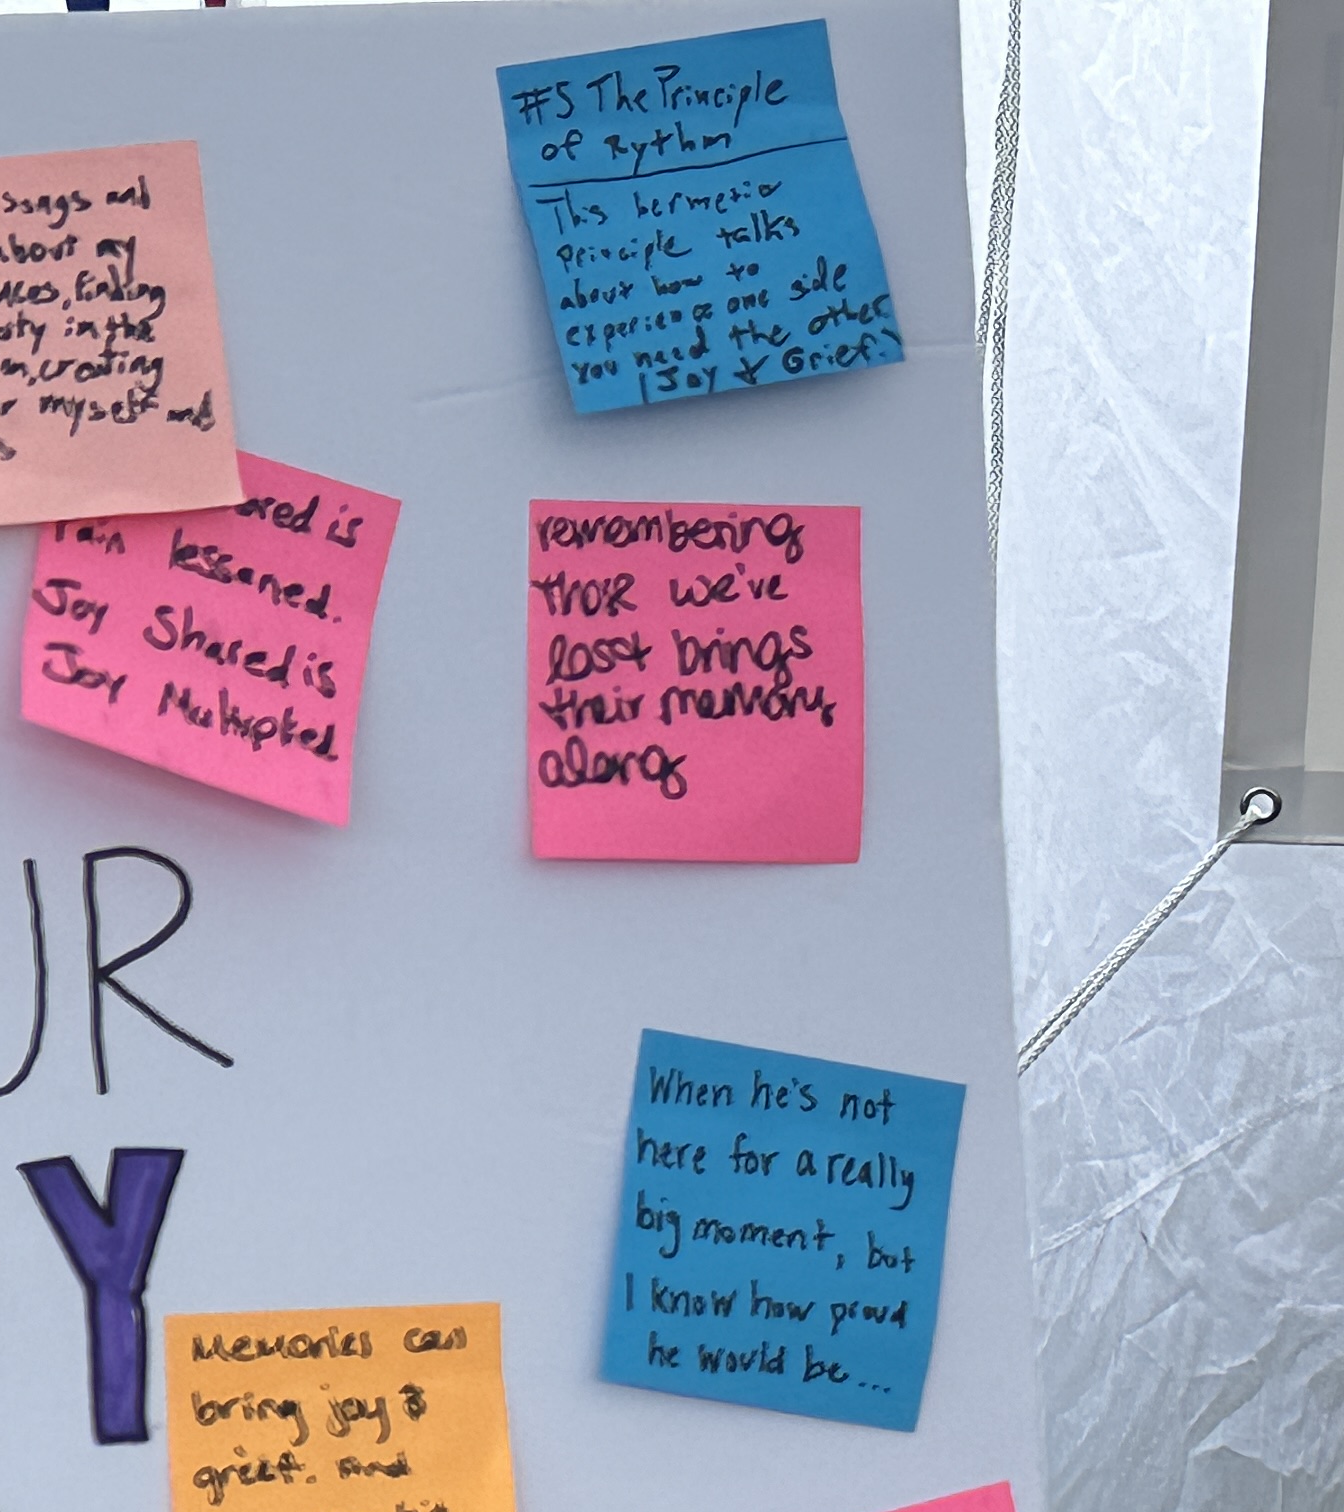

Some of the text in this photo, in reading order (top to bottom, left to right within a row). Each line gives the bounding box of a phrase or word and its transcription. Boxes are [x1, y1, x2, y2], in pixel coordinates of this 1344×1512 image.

[586, 64, 788, 128] The Principle
[541, 129, 582, 161] of
[2, 191, 92, 229] songs
[717, 210, 800, 248] talks
[96, 236, 137, 284] my
[790, 256, 847, 300] side
[560, 263, 760, 309] about to
[65, 317, 98, 337] in
[729, 294, 891, 348] the other
[326, 504, 363, 548] is
[537, 509, 805, 564] remembering
[670, 562, 789, 606] we've
[32, 578, 336, 699] Joy is
[672, 625, 814, 695] brings
[42, 642, 128, 704] Joy
[649, 1066, 896, 1126] When he's not
[636, 1127, 915, 1211] here for a really
[636, 1189, 916, 1273] big but
[625, 1272, 909, 1336] I know how proud
[192, 1325, 468, 1362] Memories can
[648, 1330, 786, 1374] he would
[191, 1382, 392, 1447] bring joy
